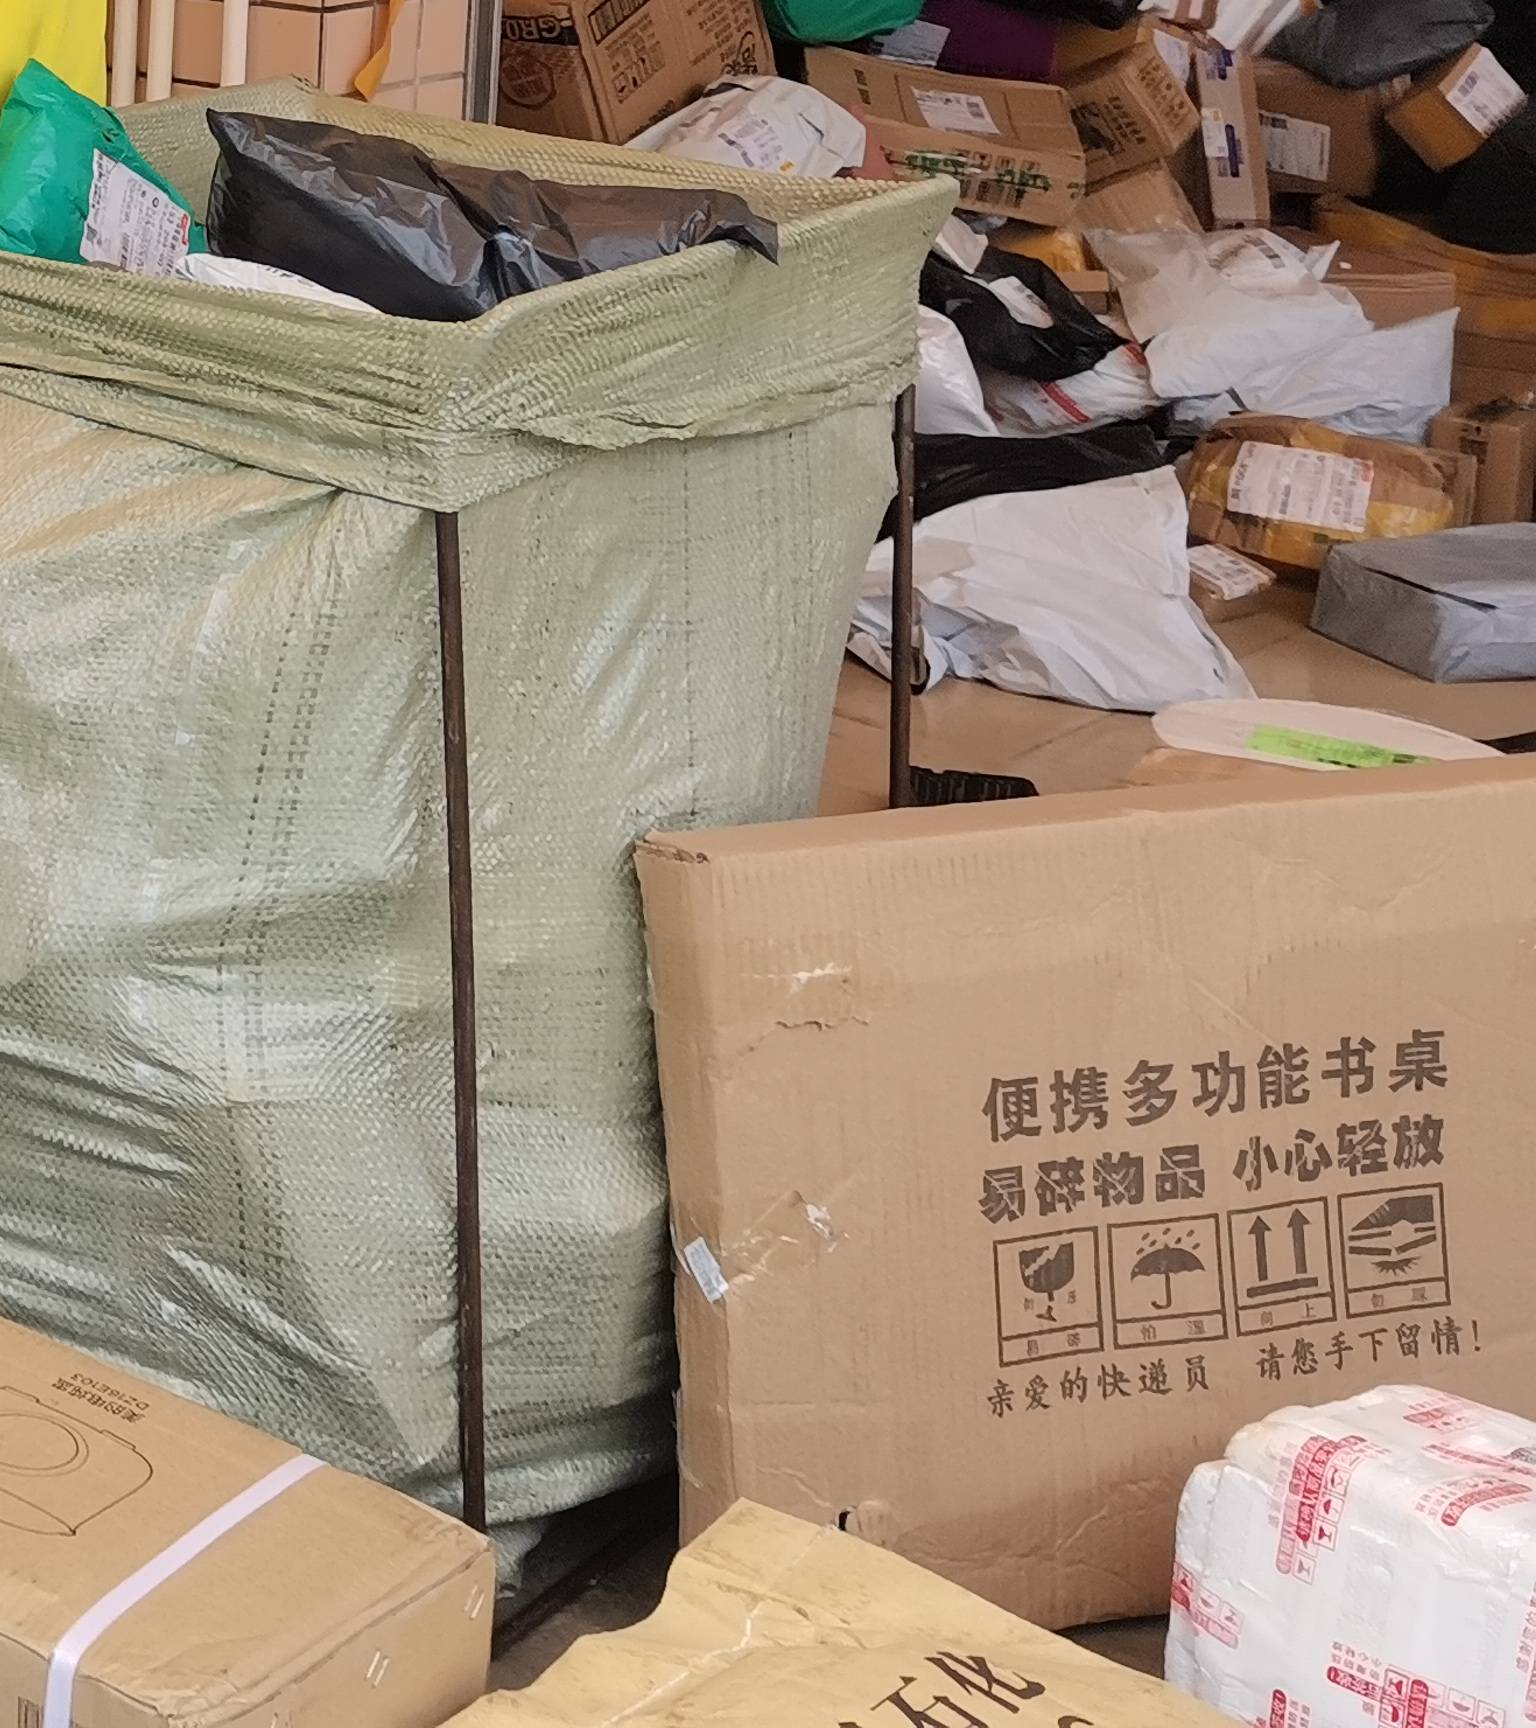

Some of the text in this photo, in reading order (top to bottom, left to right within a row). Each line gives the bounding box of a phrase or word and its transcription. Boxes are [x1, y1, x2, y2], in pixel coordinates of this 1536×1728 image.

[981, 1028, 1450, 1142] 便携多功能书桌
[978, 1113, 1445, 1224] 易碎物品 小心轻放
[1259, 1301, 1318, 1328] 向上
[985, 1354, 1210, 1419] 亲爱的快递员
